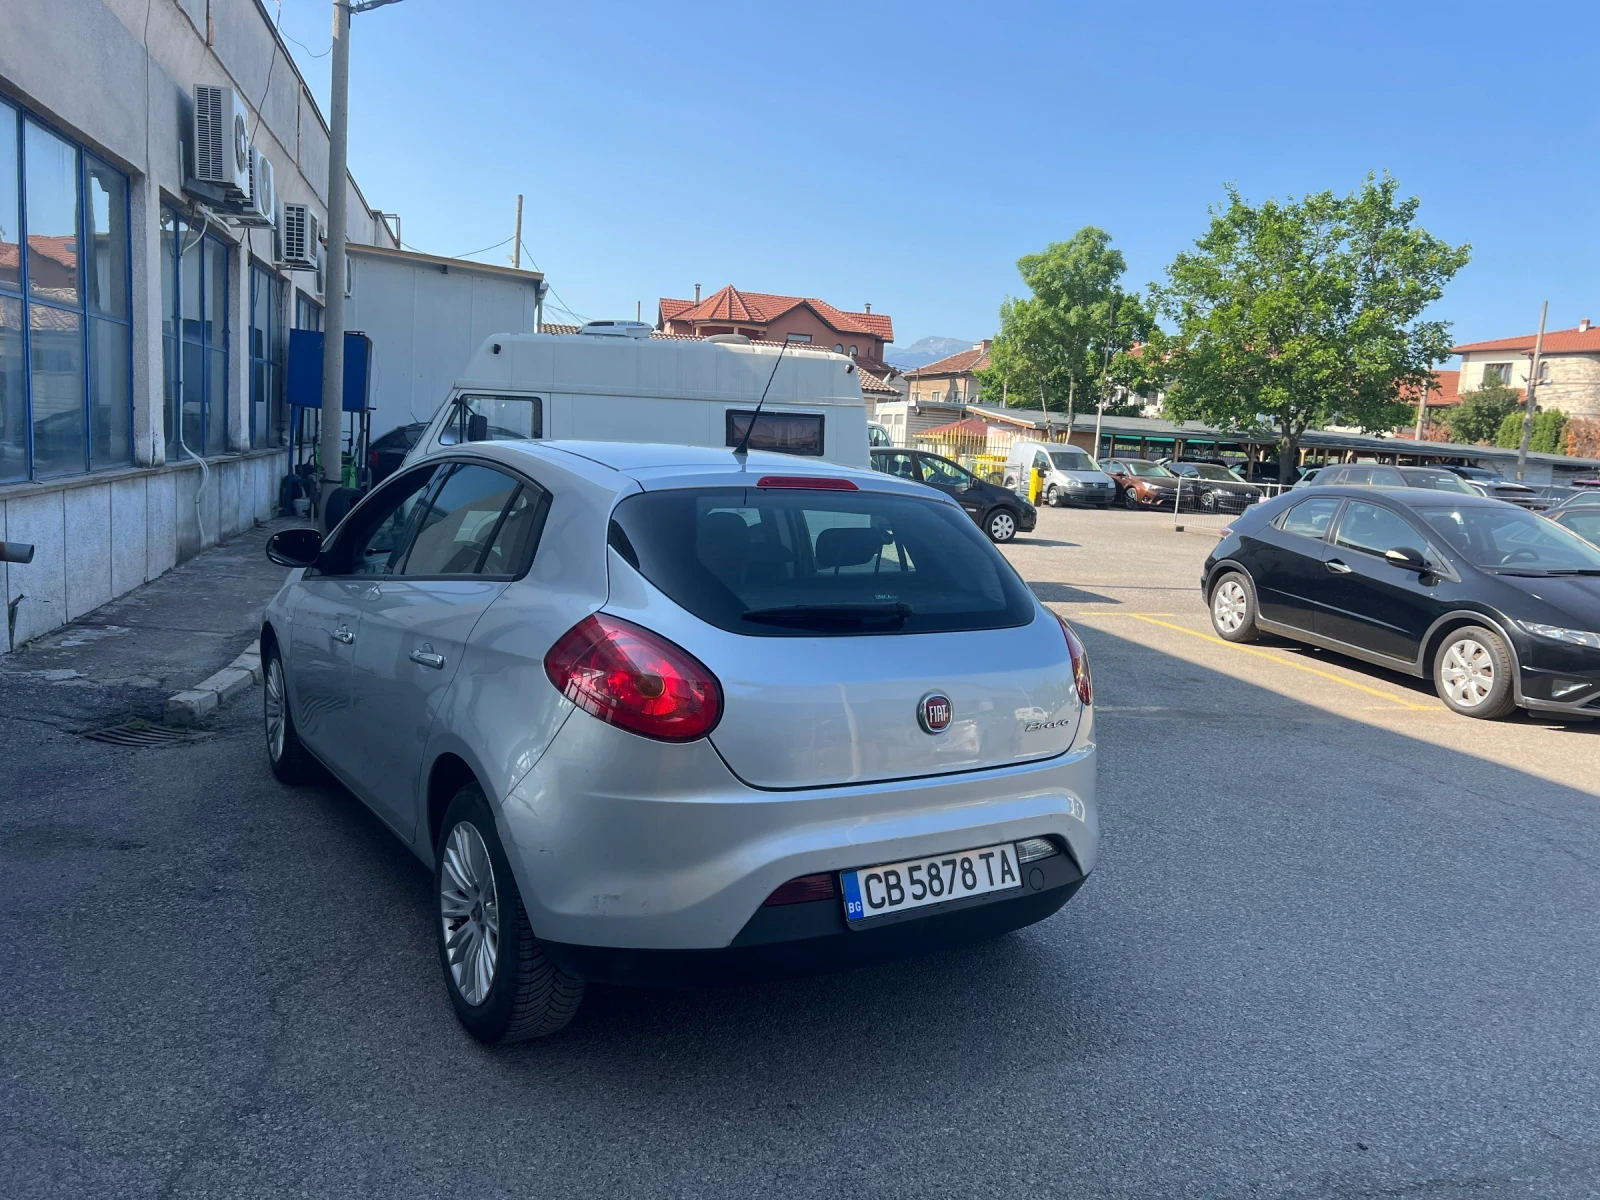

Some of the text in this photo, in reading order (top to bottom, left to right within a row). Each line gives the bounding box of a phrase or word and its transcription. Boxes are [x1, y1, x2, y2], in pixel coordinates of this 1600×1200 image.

[929, 704, 947, 723] FIAT
[1024, 719, 1071, 732] Bravo
[848, 901, 862, 914] BG
